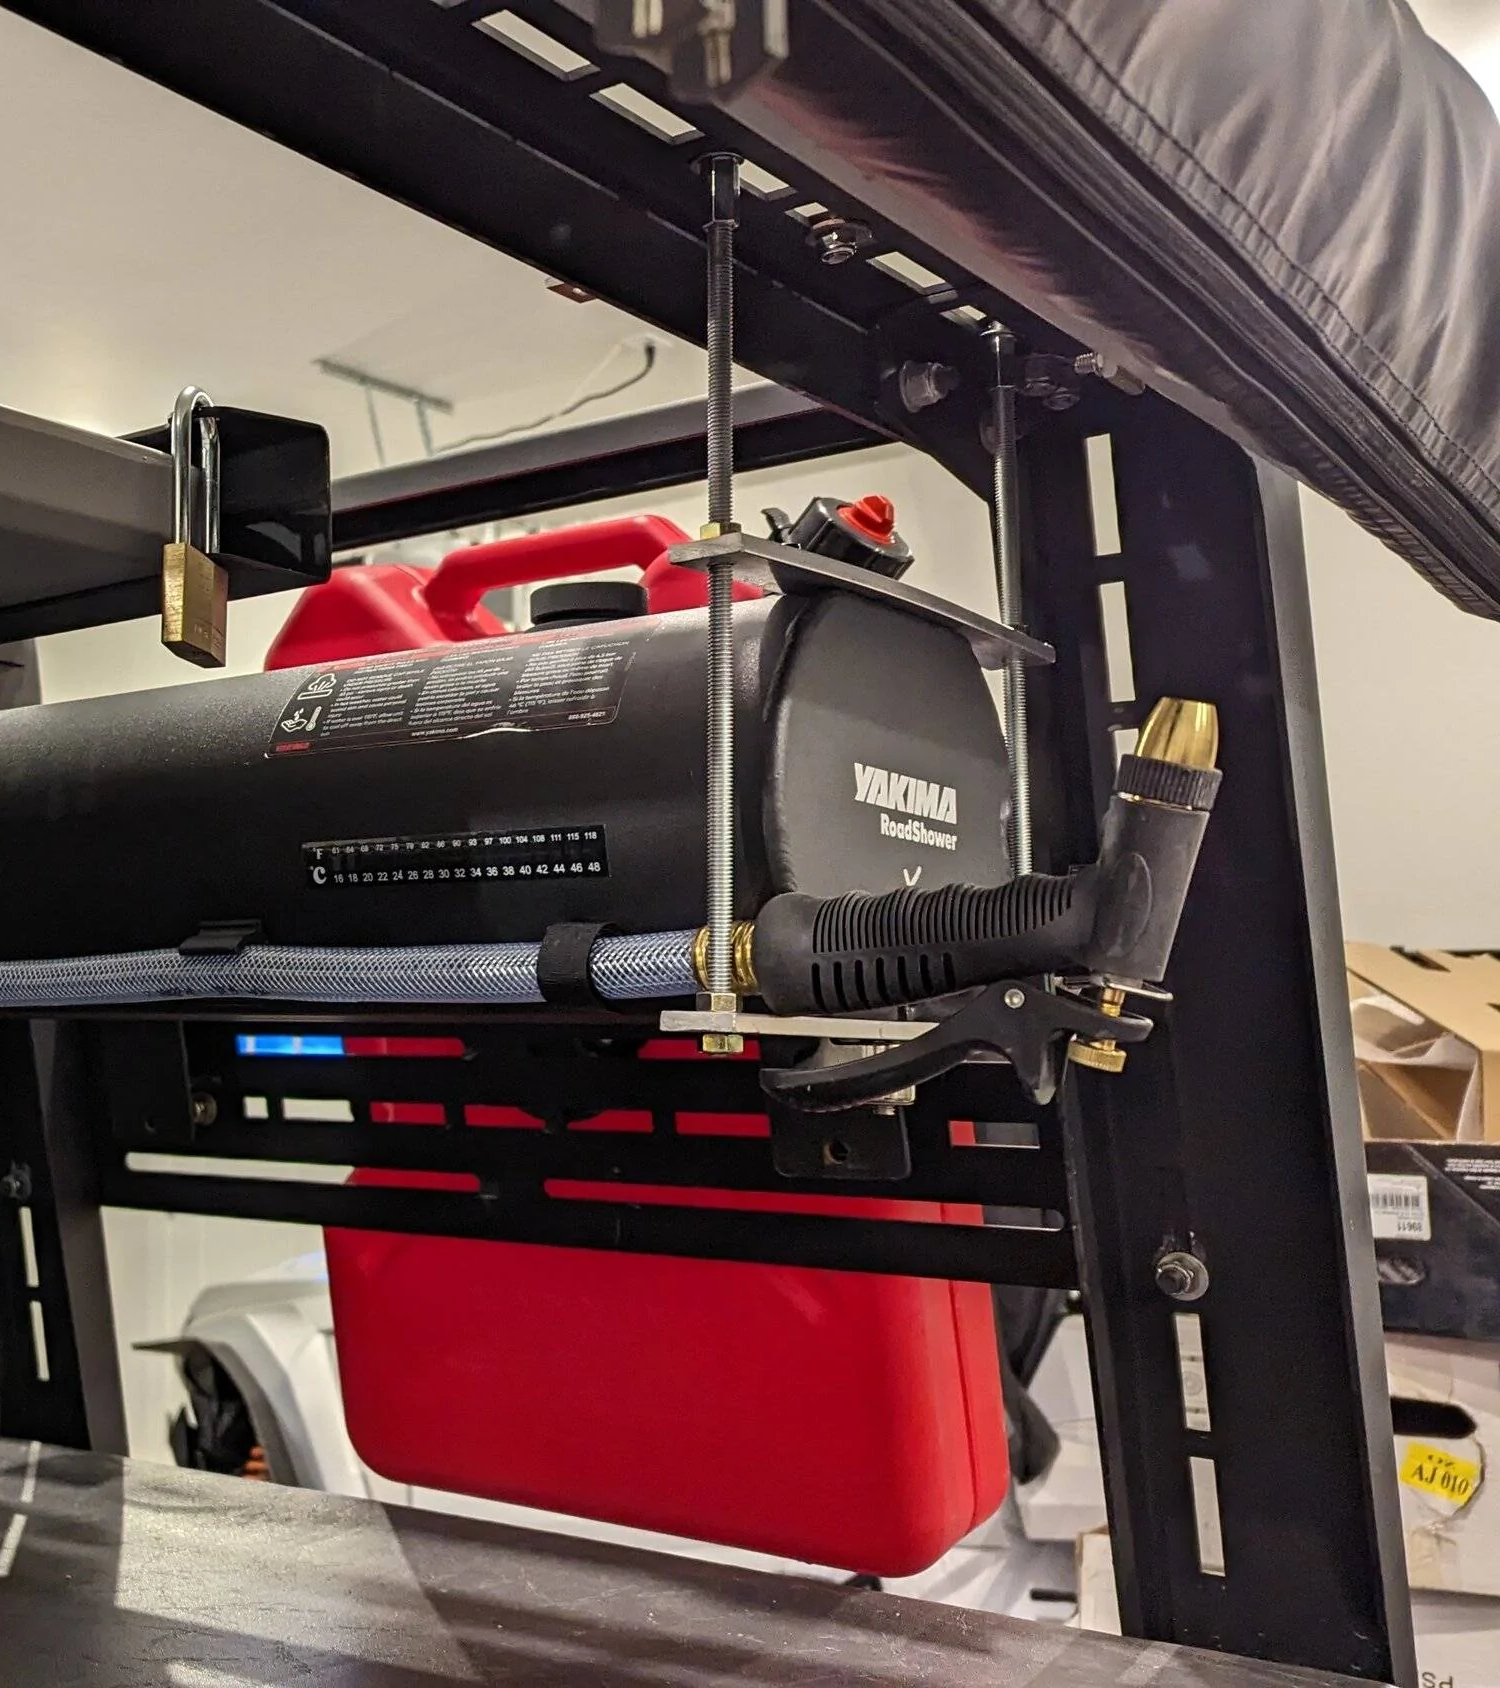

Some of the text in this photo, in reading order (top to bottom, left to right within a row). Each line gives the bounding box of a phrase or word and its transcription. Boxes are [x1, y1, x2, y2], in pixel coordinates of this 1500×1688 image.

[853, 762, 958, 825] YAKIMA
[484, 837, 493, 846] 97
[499, 836, 512, 844] 100
[516, 835, 528, 844] 104
[550, 833, 562, 842] 111
[566, 832, 580, 840] 115
[584, 831, 598, 840] 118
[880, 813, 957, 851] RoadShower
[334, 874, 344, 884] 16
[348, 873, 358, 882] 18
[362, 872, 374, 882] 20
[377, 872, 388, 882] 22
[392, 870, 404, 881] 24
[408, 870, 418, 880] 26
[423, 870, 434, 880] 28
[438, 868, 450, 878] 30
[454, 868, 466, 878] 32
[470, 867, 482, 878] 34
[486, 866, 498, 876] 36
[502, 866, 514, 876] 38
[518, 864, 532, 875] 40
[536, 864, 548, 874] 42
[553, 863, 566, 874] 44
[570, 862, 583, 873] 46
[588, 862, 601, 872] 48
